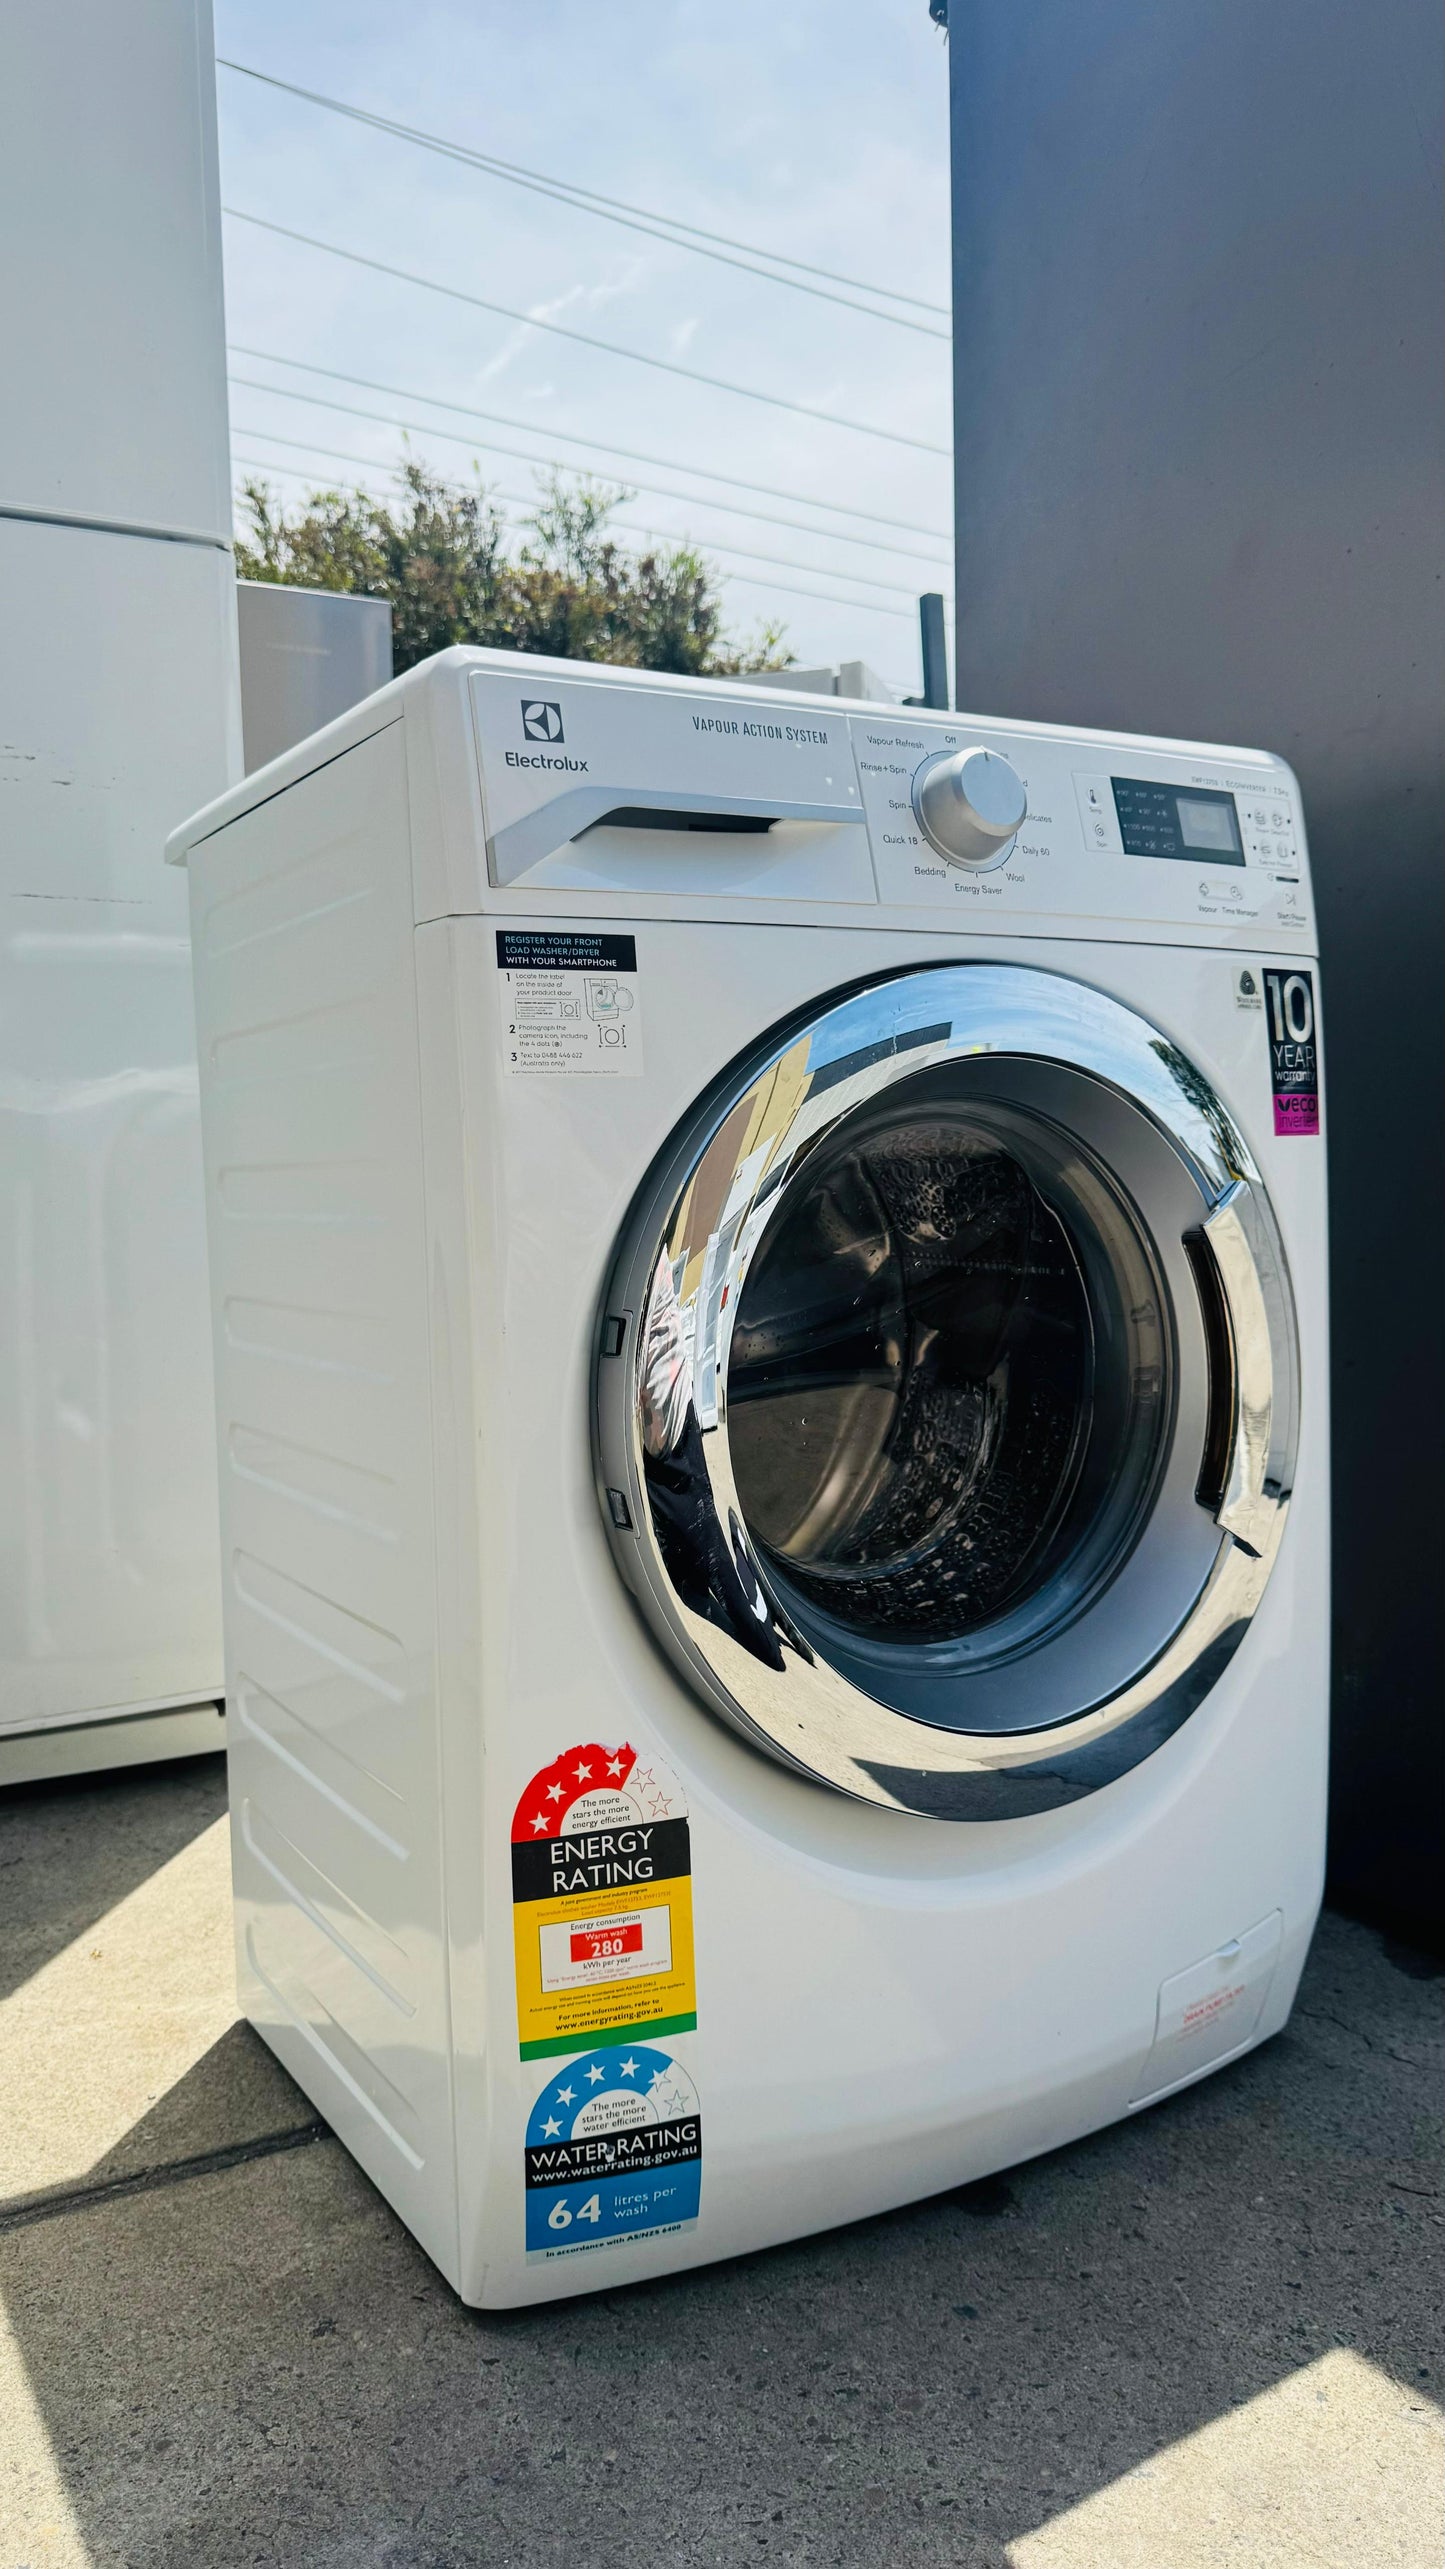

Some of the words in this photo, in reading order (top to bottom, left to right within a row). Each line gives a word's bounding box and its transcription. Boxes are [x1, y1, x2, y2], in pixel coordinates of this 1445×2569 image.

[867, 736, 893, 746] Vapour
[896, 738, 924, 749] Refresh
[945, 736, 956, 744] Off
[505, 752, 589, 772] Electrolux
[889, 800, 906, 810] Spin
[883, 834, 905, 845] Quick
[908, 837, 918, 845] 18
[1022, 846, 1038, 856] Daily
[914, 867, 947, 878] Bedding
[1006, 873, 1025, 882] Wool
[955, 883, 980, 895] Energy
[981, 885, 1002, 895] Saver
[504, 935, 546, 945] REGISTER
[548, 937, 572, 946] YOUR
[574, 938, 603, 946] FRONT
[505, 946, 530, 954] LOAD
[532, 947, 600, 956] WASHER/DRYER
[531, 957, 556, 965] YOUR
[558, 958, 617, 967] SMARTPHONE
[506, 972, 510, 982] 1
[531, 990, 556, 998] product
[1267, 975, 1313, 1042] 10
[509, 1024, 516, 1034] 2
[510, 1053, 517, 1061] 3
[1273, 1045, 1315, 1068] YEAR
[1275, 1070, 1315, 1085] warranty
[581, 1799, 597, 1808] The
[599, 1797, 620, 1806] more
[572, 1810, 591, 1819] stars
[593, 1807, 606, 1817] the
[608, 1805, 630, 1814] more
[572, 1818, 598, 1830] energy
[600, 1814, 631, 1825] efficient
[550, 1828, 654, 1864] ENERGY
[553, 1857, 654, 1893] RATING
[570, 1920, 594, 1932] Energy
[595, 1913, 641, 1927] consumption
[585, 1931, 608, 1941] Warm
[609, 1928, 628, 1938] wash
[591, 1938, 623, 1958] 280
[583, 1961, 600, 1970] kWh
[603, 1960, 616, 1969] per
[618, 1956, 631, 1967] year
[558, 2013, 570, 2021] For
[572, 2010, 590, 2018] more
[592, 2002, 632, 2015] information,
[634, 1999, 649, 2007] refer
[555, 2006, 662, 2031] www.energyrating.gov.au
[592, 2102, 610, 2112] The
[612, 2098, 636, 2109] more
[582, 2113, 603, 2123] stars
[605, 2109, 620, 2119] the
[622, 2105, 647, 2116] more
[583, 2122, 610, 2133] water
[612, 2115, 646, 2128] efficient
[531, 2142, 609, 2169] WATER
[617, 2123, 696, 2156] RATING
[531, 2144, 698, 2183] www.waterrating.gov.au
[548, 2193, 602, 2230] 64
[614, 2192, 649, 2206] litres
[654, 2186, 677, 2203] per
[614, 2204, 648, 2219] wash
[557, 2242, 604, 2255] accordance
[606, 2237, 625, 2245] with
[627, 2229, 660, 2241] AS/NZS
[662, 2224, 682, 2233] 6400
